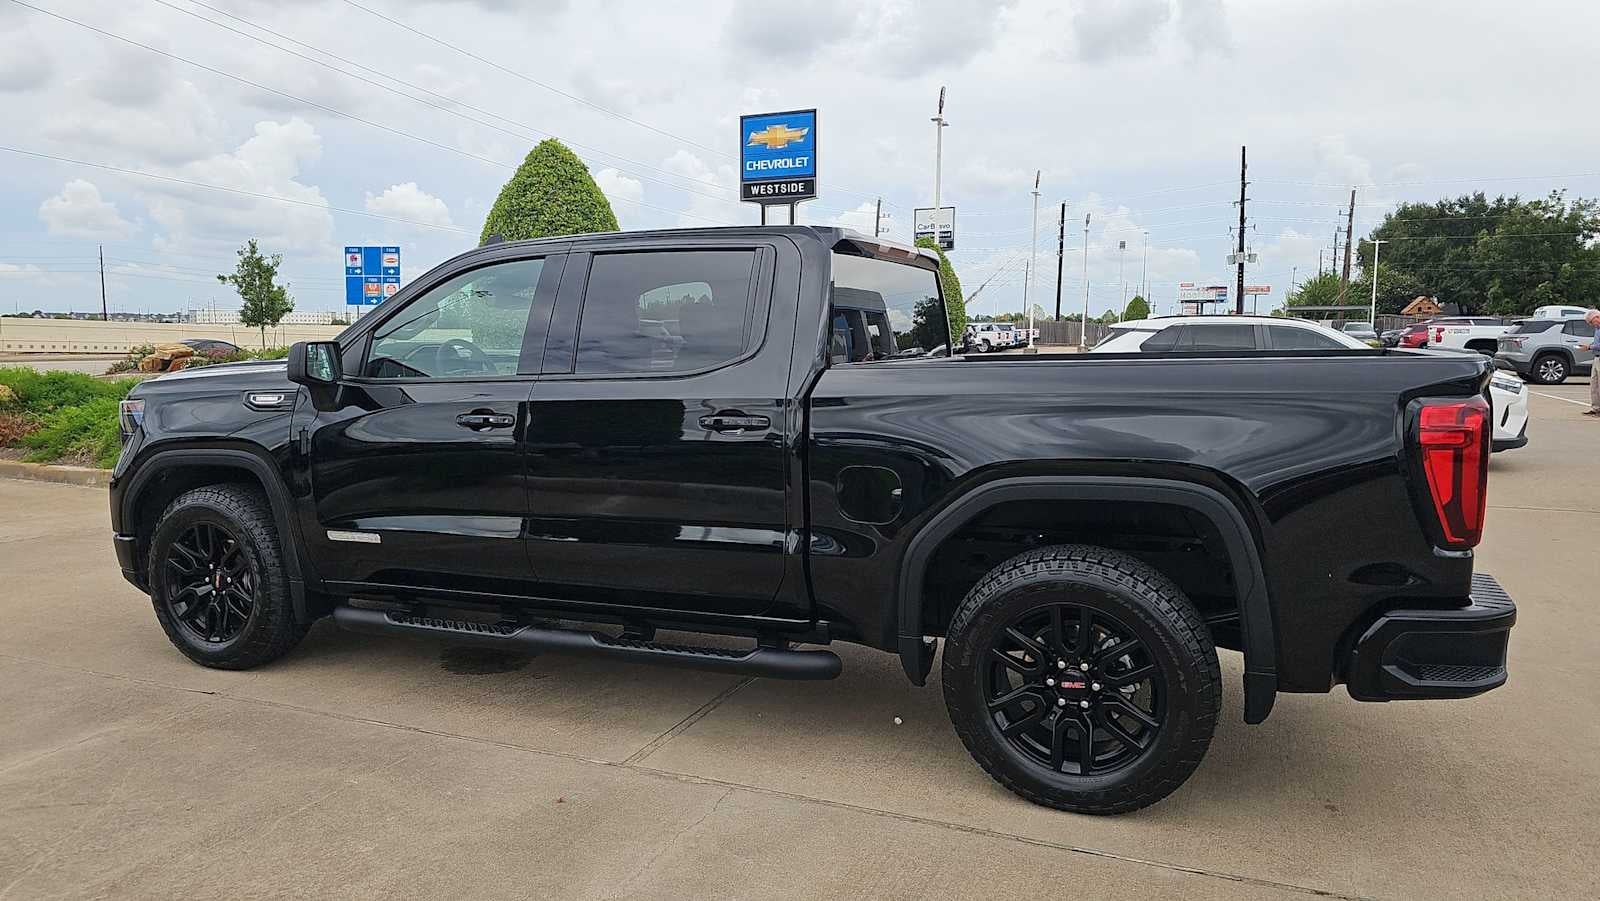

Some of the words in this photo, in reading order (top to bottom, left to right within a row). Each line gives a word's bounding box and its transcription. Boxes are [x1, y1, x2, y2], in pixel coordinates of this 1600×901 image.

[746, 157, 809, 171] CHEVROLET
[750, 183, 805, 195] WESTSIDE
[1061, 681, 1086, 689] GMC
